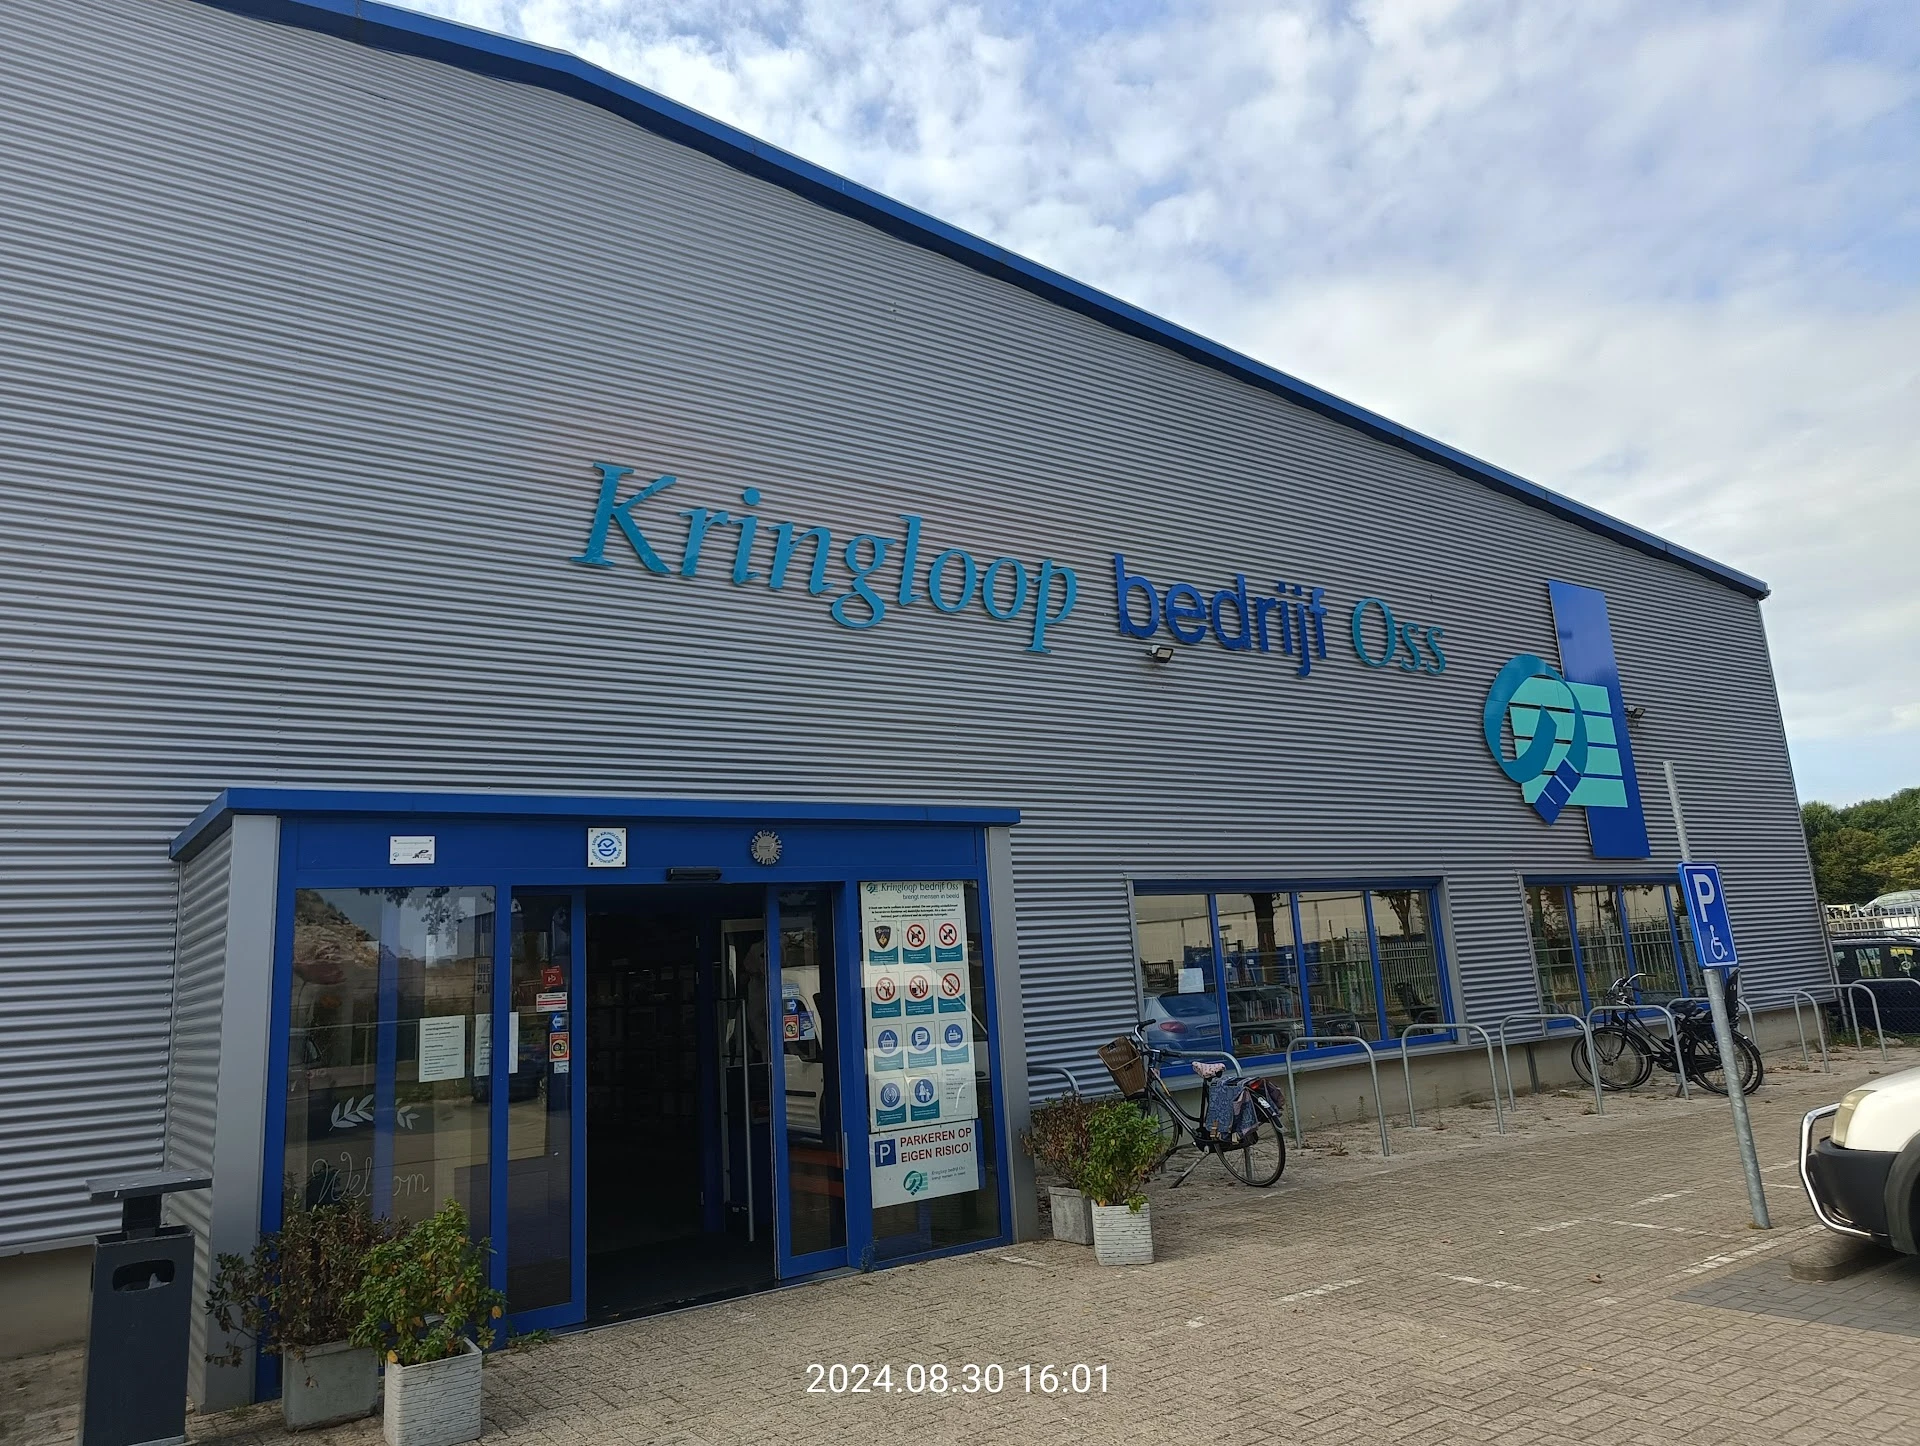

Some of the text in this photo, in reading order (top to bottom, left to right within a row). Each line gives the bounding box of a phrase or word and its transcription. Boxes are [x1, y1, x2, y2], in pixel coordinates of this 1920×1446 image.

[570, 462, 1446, 679] Kringloop bedrijf Oss
[881, 881, 959, 893] Kringloop bedrijf Oss
[1692, 873, 1715, 923] P
[900, 1127, 972, 1148] PARKEREN OP
[879, 1143, 891, 1164] P
[901, 1142, 972, 1163] EIGEN RISICO!
[311, 1151, 430, 1204] Welom
